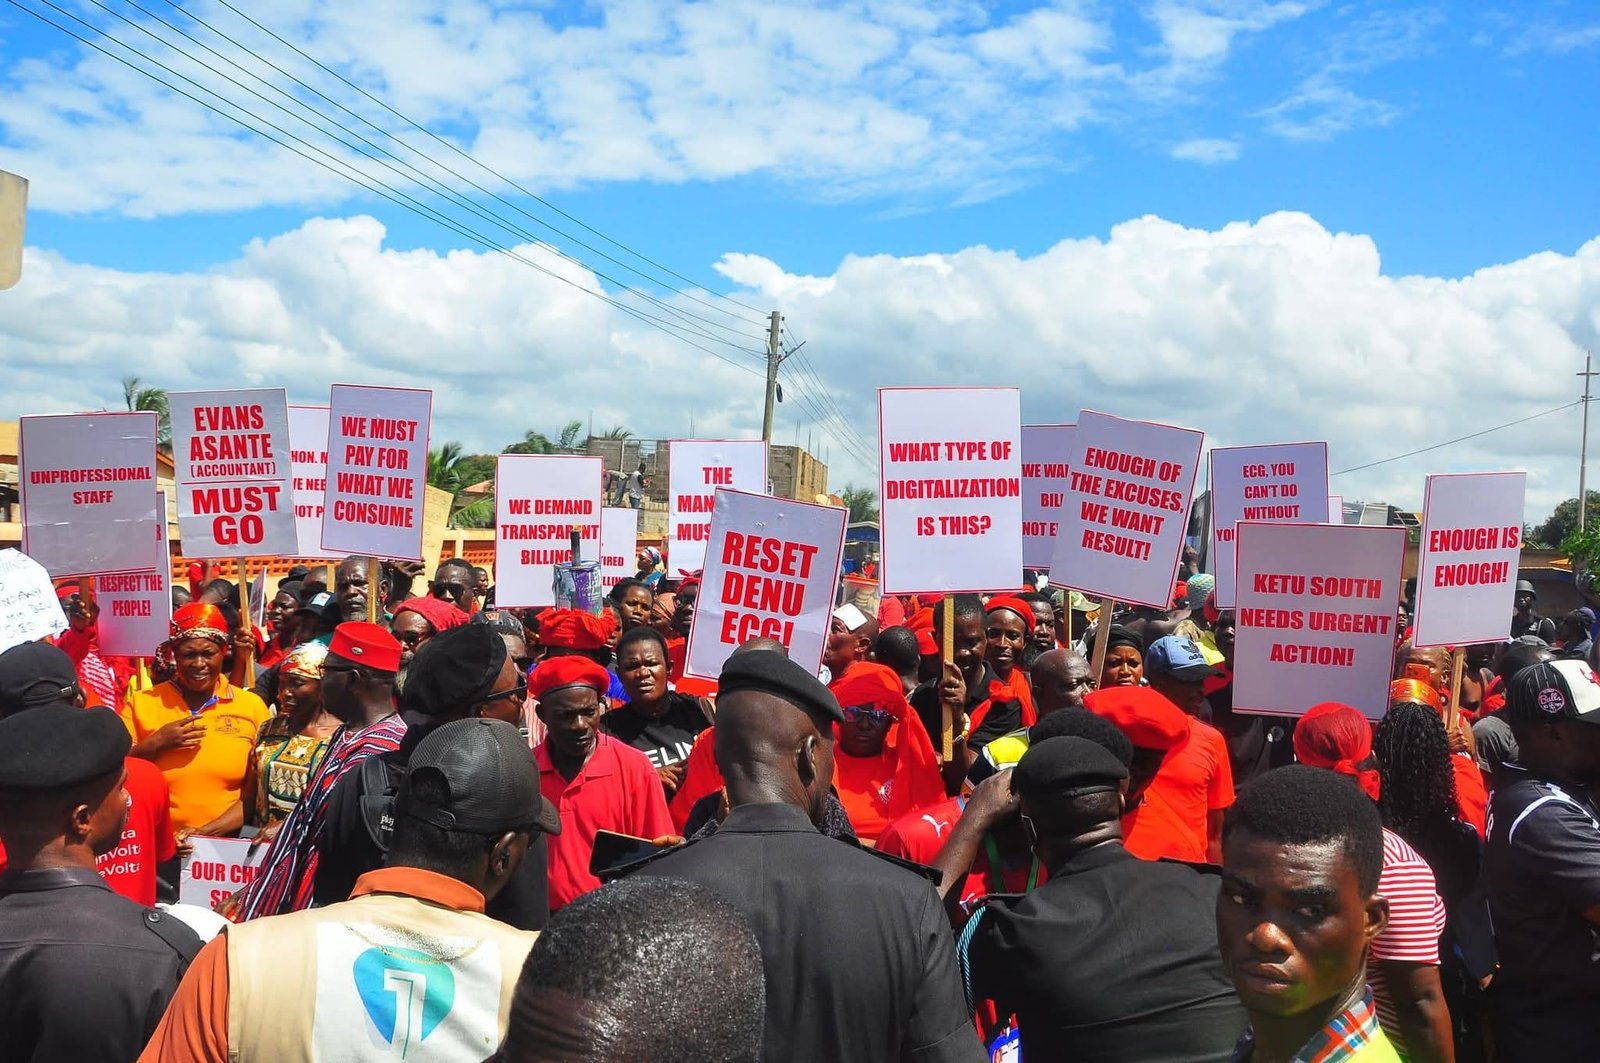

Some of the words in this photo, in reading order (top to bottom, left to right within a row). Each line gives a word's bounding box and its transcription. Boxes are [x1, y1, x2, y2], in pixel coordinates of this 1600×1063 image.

[194, 405, 263, 431] EVANS
[342, 417, 366, 437] WE
[371, 418, 418, 441] MUST
[191, 434, 272, 461] ASANTE
[346, 445, 374, 466] PAY
[378, 447, 408, 470] FOR
[889, 442, 940, 462] WHAT
[945, 442, 986, 460] TYPE
[991, 442, 1010, 460] OF
[31, 467, 150, 484] UNPROFESSIONAL
[191, 461, 276, 477] (ACCOUNTANT)
[703, 467, 732, 484] THE
[1023, 464, 1040, 477] WE
[1085, 447, 1154, 478] ENOUGH
[1159, 460, 1182, 483] OF
[1243, 465, 1269, 479] ECG,
[1271, 463, 1295, 476] YOU
[73, 490, 113, 505] STAFF
[337, 473, 384, 497] WHAT
[388, 478, 413, 499] WE
[887, 478, 1019, 499] DIGITALIZATION
[1072, 472, 1101, 495] THE
[1105, 480, 1184, 514] EXCUSES,
[1245, 485, 1278, 499] CAN'T
[1281, 484, 1298, 497] DO
[192, 486, 280, 514] MUST
[509, 500, 530, 514] WE
[535, 500, 592, 514] DEMAND
[334, 500, 413, 528] CONSUME
[1081, 502, 1108, 525] WE
[1111, 508, 1164, 536] WANT
[1244, 505, 1300, 519] WITHOUT
[213, 515, 263, 545] GO
[918, 517, 934, 535] IS
[939, 516, 991, 535] THIS?
[1023, 522, 1046, 535] NOT
[1082, 529, 1151, 560] RESULT!
[1430, 528, 1498, 552] ENOUGH
[1502, 527, 1518, 548] IS
[521, 550, 572, 564] BILLING
[722, 531, 818, 579] RESET
[100, 575, 141, 592] RESPECT
[143, 575, 163, 591] THE
[1435, 562, 1508, 587] ENOUGH!
[721, 570, 805, 617] DENU
[1254, 574, 1305, 595] KETU
[1311, 576, 1381, 599] SOUTH
[112, 600, 151, 616] PEOPLE!
[1241, 608, 1304, 630] NEEDS
[1309, 612, 1390, 634] URGENT
[1270, 644, 1354, 666] ACTION!
[192, 862, 225, 881] OUR
